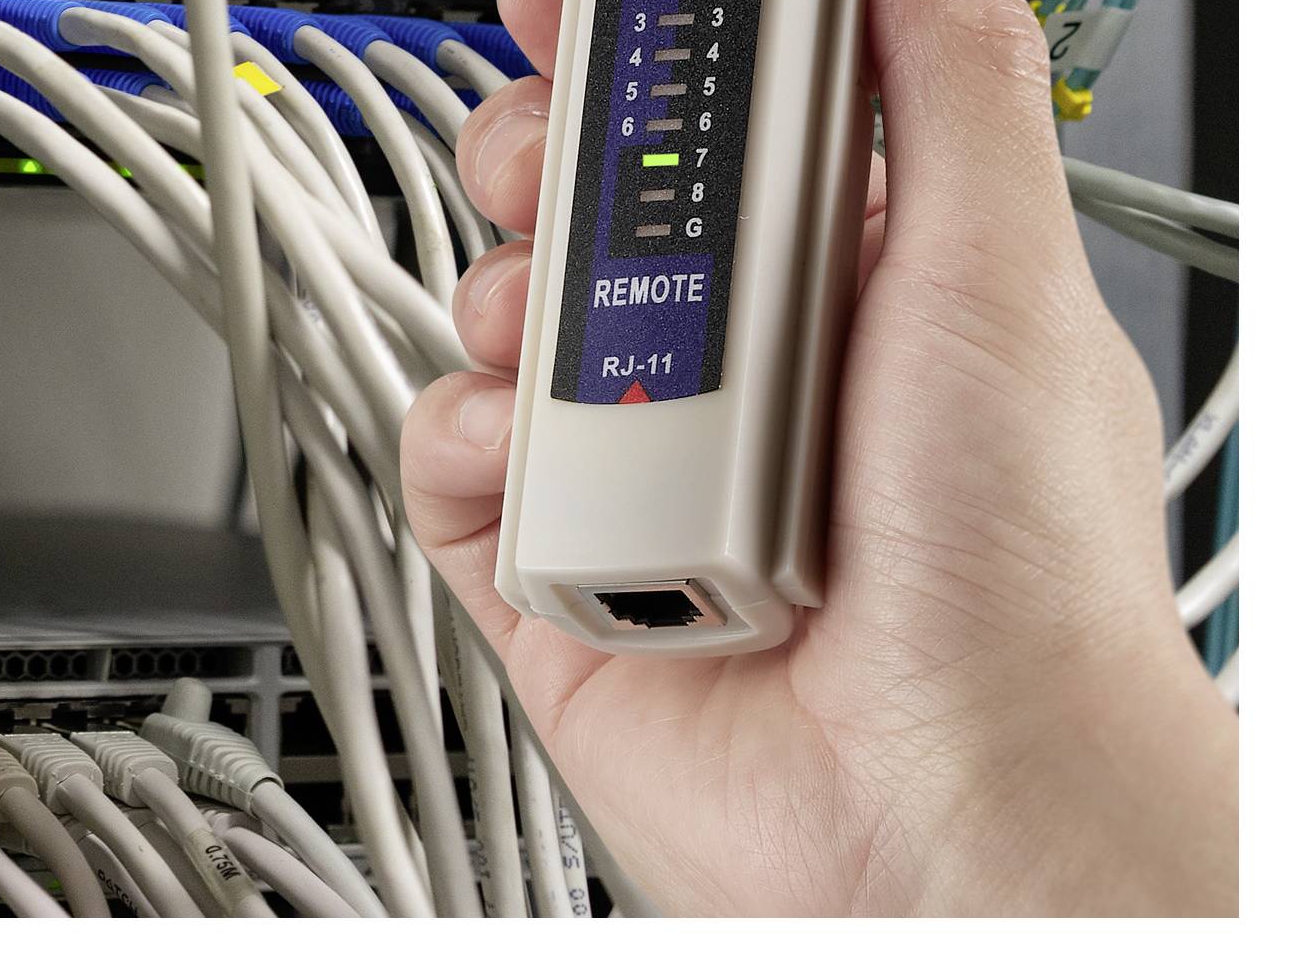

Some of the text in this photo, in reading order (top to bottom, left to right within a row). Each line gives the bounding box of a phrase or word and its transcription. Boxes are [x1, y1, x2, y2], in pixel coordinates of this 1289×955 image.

[634, 7, 724, 32] 3 3
[629, 42, 720, 67] 4 4
[625, 76, 716, 101] 5 5
[621, 111, 712, 137] 6 6
[695, 147, 709, 168] 7
[691, 182, 705, 203] 8
[685, 217, 703, 238] G
[593, 273, 705, 308] REMOTE
[602, 353, 672, 378] RJ-11
[205, 845, 242, 882] 0.75M
